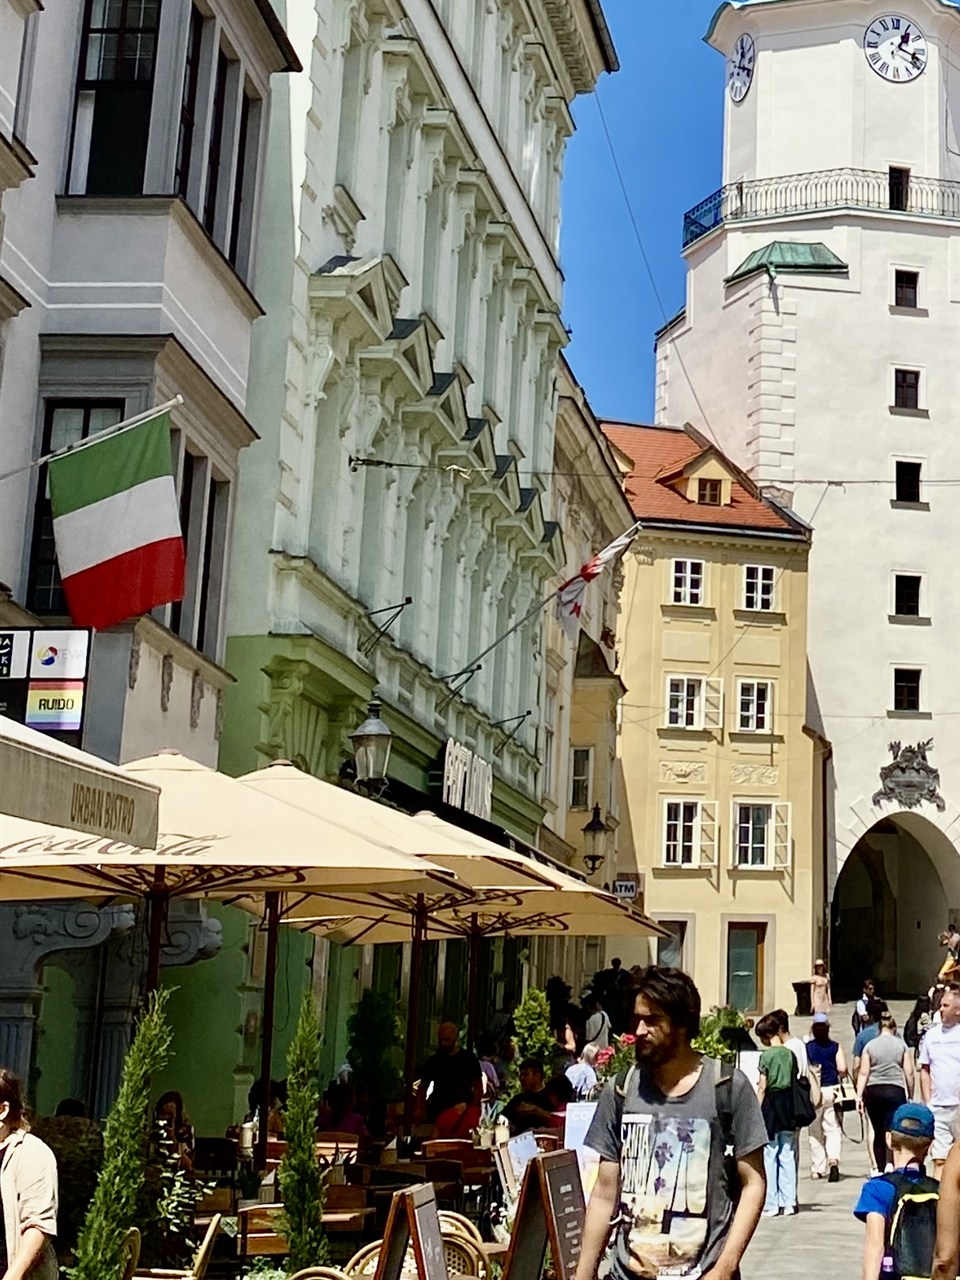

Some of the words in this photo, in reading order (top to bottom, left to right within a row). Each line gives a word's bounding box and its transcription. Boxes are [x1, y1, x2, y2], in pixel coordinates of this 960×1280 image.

[71, 782, 104, 827] URBAN
[104, 791, 135, 835] BISTRO
[0, 833, 231, 859] CocaCla
